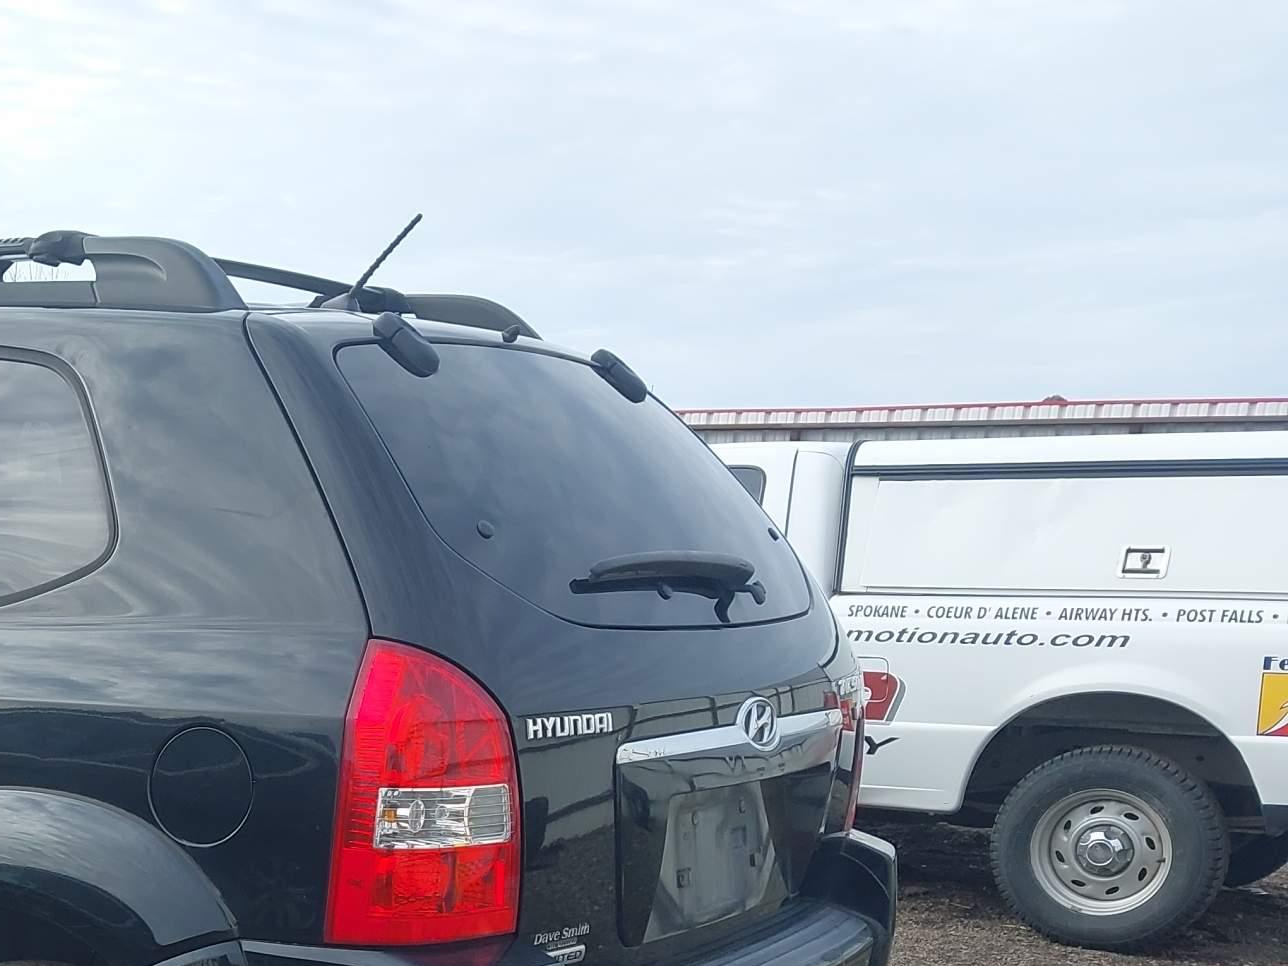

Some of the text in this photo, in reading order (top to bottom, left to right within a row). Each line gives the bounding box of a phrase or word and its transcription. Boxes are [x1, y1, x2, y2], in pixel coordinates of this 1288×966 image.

[847, 605, 908, 619] SPOKANE
[926, 605, 973, 620] COEUR
[994, 606, 1039, 621] ALENE
[1058, 607, 1118, 621] AIRWAY
[1120, 608, 1153, 622] HTS.
[1176, 609, 1216, 623] POST
[1220, 609, 1264, 624] FALLS
[526, 712, 613, 740] HYUNDAI
[533, 930, 561, 946] Dave
[561, 922, 590, 939] Smith
